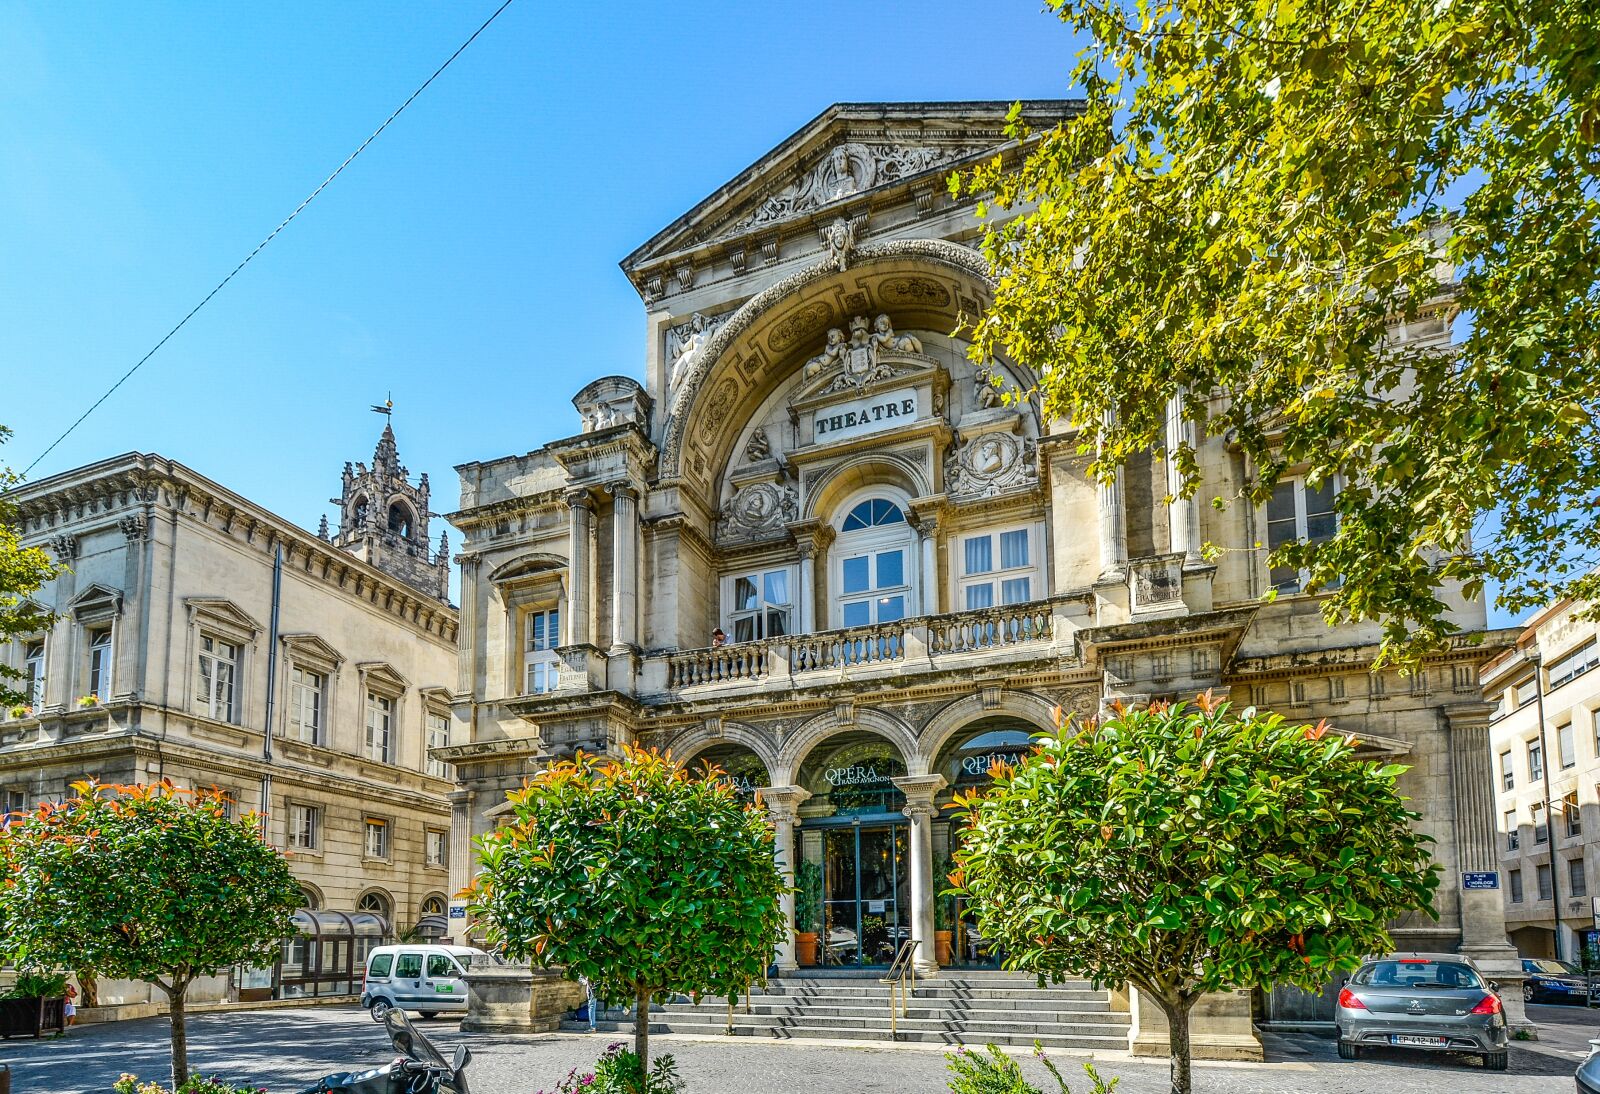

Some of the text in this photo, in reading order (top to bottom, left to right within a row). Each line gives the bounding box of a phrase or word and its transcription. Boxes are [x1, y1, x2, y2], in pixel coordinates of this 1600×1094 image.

[816, 398, 915, 434] THEATRE
[825, 764, 877, 781] OPÉRA
[830, 774, 890, 786] GRAND AVIGNON
